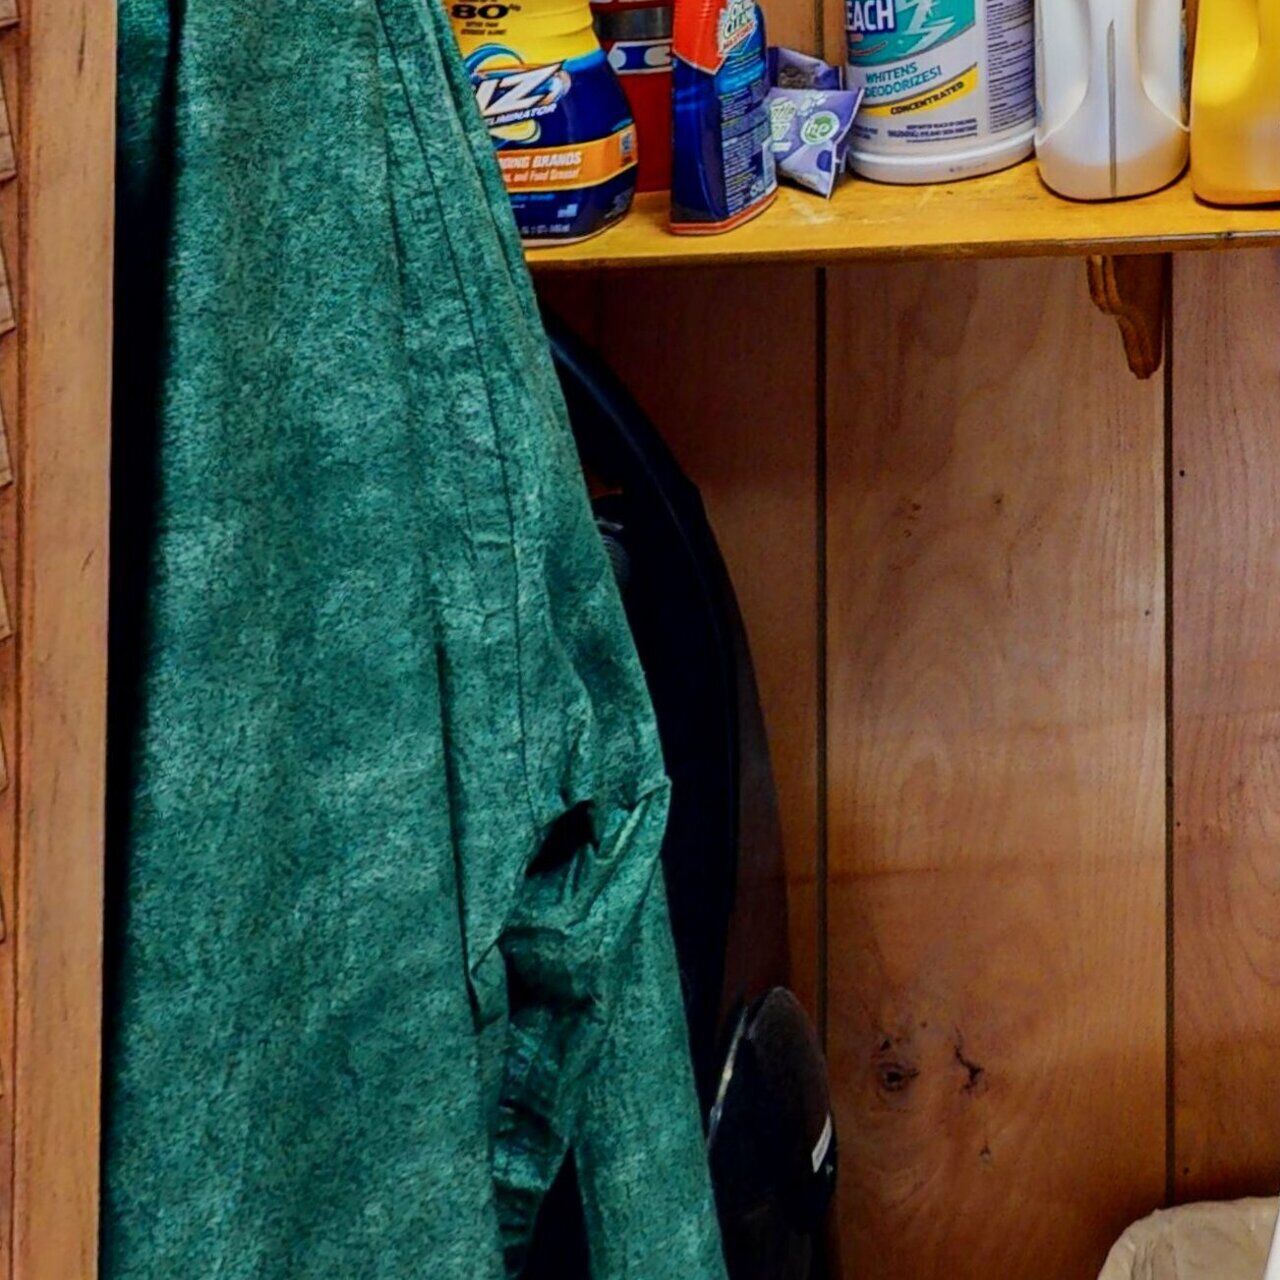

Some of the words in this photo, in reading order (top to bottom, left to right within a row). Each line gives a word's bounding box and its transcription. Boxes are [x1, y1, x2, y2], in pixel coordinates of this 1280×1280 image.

[452, 4, 509, 19] 80
[865, 66, 941, 99] DEODORIZES!
[866, 62, 918, 83] WHITENS
[891, 81, 964, 115] CONCENTRATED
